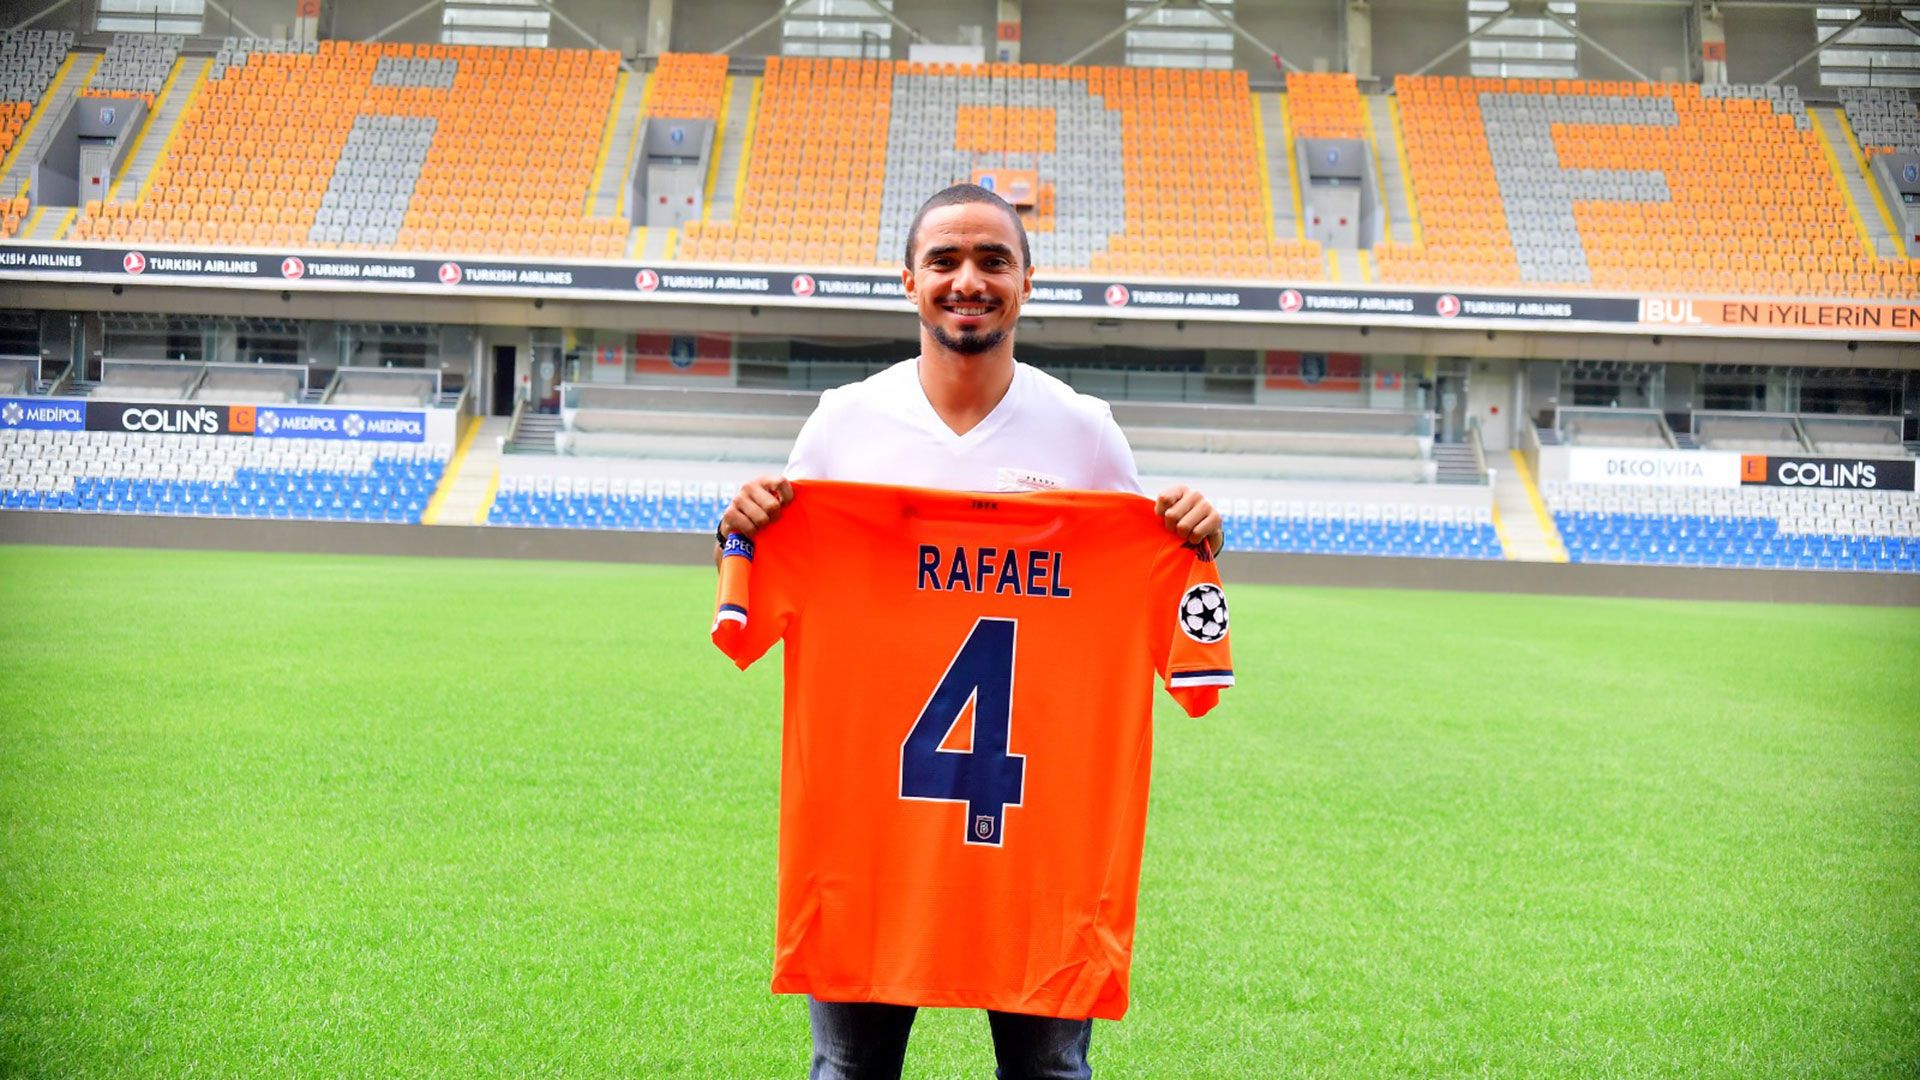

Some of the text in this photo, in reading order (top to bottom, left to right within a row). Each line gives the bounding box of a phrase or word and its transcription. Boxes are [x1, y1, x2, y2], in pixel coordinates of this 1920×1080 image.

[28, 253, 82, 267] AIRLINES
[150, 257, 258, 273] TURKISH AIRLINES
[308, 263, 416, 279] TURKISH AIRLINES
[465, 268, 573, 284] TURKISH AIRLINES
[662, 275, 769, 291] TURKISH AIRLINES
[818, 280, 870, 294] TURKISH
[1132, 290, 1240, 306] TURKISH AIRLINES
[1306, 295, 1414, 311] TURKISH AIRLINES
[1464, 301, 1572, 317] TURKISH AIRLINES
[1722, 303, 1758, 323] EN
[122, 406, 219, 433] COLIN'S
[236, 410, 249, 425] C
[1778, 461, 1877, 488] COLIN'S
[917, 544, 1073, 599] RAFAEL
[899, 615, 1026, 848] 4
